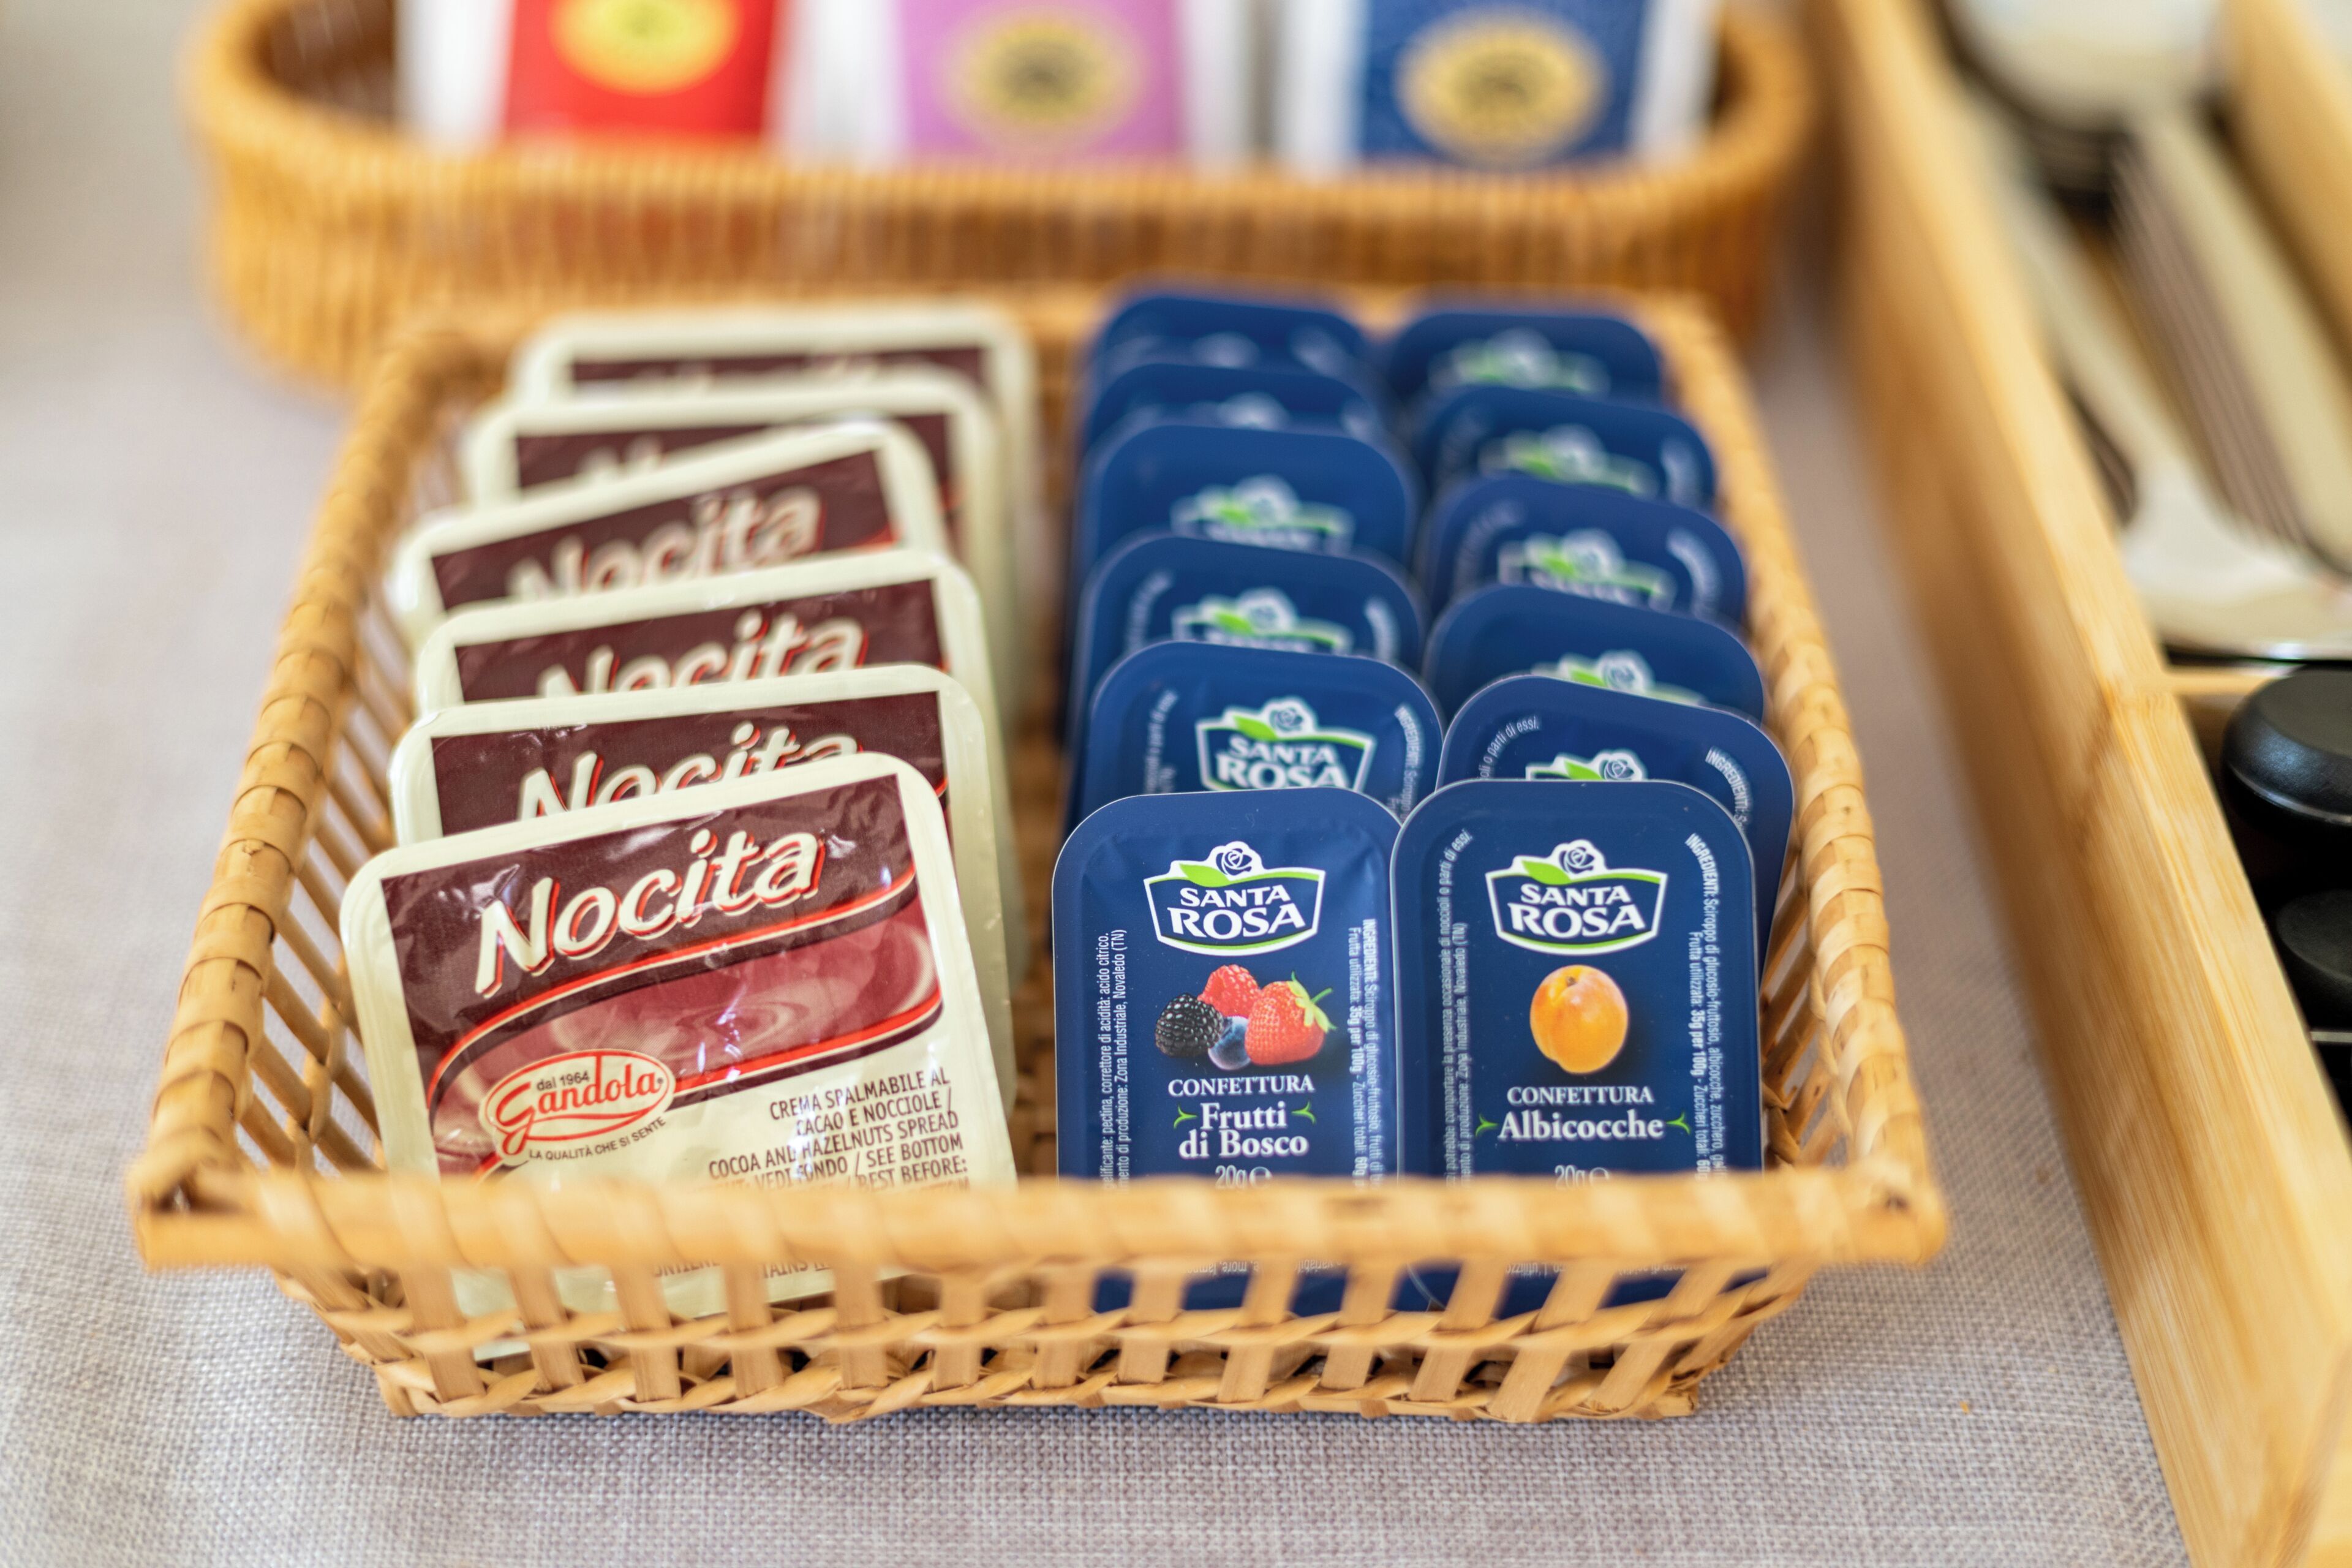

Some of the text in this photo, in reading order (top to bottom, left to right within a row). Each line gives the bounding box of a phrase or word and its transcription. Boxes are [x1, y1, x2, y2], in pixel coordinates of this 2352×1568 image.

[1227, 736, 1337, 766] SANTA
[1487, 731, 1507, 758] parti
[1505, 722, 1516, 738] di
[1516, 715, 1539, 733] essi.
[1216, 751, 1348, 790] ROSA
[1705, 747, 1749, 813] INGREDIENTI:
[1443, 847, 1457, 862] di
[1451, 828, 1474, 853] essi.
[1439, 859, 1453, 886] parti
[1684, 832, 1719, 897] INGREDIENTI:
[1179, 883, 1292, 908] SANTA
[1520, 883, 1632, 907] SANTA
[475, 829, 826, 1000] Nocita
[1167, 903, 1306, 941] ROSA
[1507, 904, 1646, 938] ROSA
[1702, 898, 1719, 942] Sciroppo
[1096, 933, 1109, 966] citrico.
[1111, 929, 1128, 951] (TN)
[1348, 927, 1361, 957] Frutta
[1438, 937, 1450, 947] di
[1452, 922, 1469, 946] (TN)
[1689, 932, 1704, 960] Frutta
[1705, 944, 1720, 954] di
[1362, 918, 1378, 982] INGREDIENTI:
[1096, 968, 1110, 995] acido
[1112, 954, 1126, 999] Novaledo
[1349, 958, 1362, 1003] utilizzata:
[1453, 948, 1467, 994] Novaledo
[1689, 963, 1704, 1007] utilizzata:
[1096, 997, 1111, 1031] acidità:
[1348, 1005, 1362, 1026] 35g
[1364, 984, 1378, 1028] Sciroppo
[1703, 956, 1722, 1045] glucosio-fruttosio,
[1113, 1001, 1129, 1055] Industriale,
[1689, 1009, 1705, 1029] 35g
[1098, 1034, 1110, 1043] di
[1347, 1027, 1361, 1045] per
[1366, 1031, 1379, 1041] di
[1689, 1031, 1705, 1049] per
[1098, 1046, 1112, 1094] correttore
[1114, 1057, 1128, 1082] Zona
[1349, 1047, 1365, 1074] 100g
[1690, 1050, 1707, 1076] 100g
[1708, 1047, 1724, 1102] albicocche,
[537, 1070, 590, 1091] dal 1964
[769, 1067, 951, 1120] CREMA SPALMABILE AL
[1168, 1074, 1315, 1097] CONFETTURA
[1506, 1085, 1655, 1106] CONFETTURA
[496, 1055, 660, 1156] Gandola
[796, 1110, 843, 1136] CACAO
[850, 1108, 859, 1126] E
[864, 1091, 943, 1121] NOCCIOLE
[1099, 1096, 1115, 1134] pectina,
[1115, 1084, 1131, 1142] produzione:
[1200, 1101, 1287, 1130] Frutti
[1352, 1082, 1366, 1124] Zuccheri
[1694, 1085, 1709, 1127] Zuccheri
[529, 1117, 666, 1161] LA QUALITÀ CHE SI SENTE
[1354, 1126, 1366, 1154] totali:
[1498, 1108, 1665, 1141] Albicocche
[1709, 1104, 1725, 1152] zucchero,
[709, 1153, 761, 1181] COCOA
[801, 1122, 893, 1159] HAZELNUTS
[899, 1110, 959, 1139] SPREAD
[866, 1145, 895, 1168] SEE
[901, 1132, 963, 1161] BOTTOM
[1115, 1144, 1128, 1153] di
[1178, 1129, 1310, 1159] di Bosco
[1368, 1134, 1383, 1159] frutti
[1695, 1129, 1709, 1157] totali:
[858, 1168, 895, 1193] BEST
[900, 1155, 968, 1185] BEFORE:
[1352, 1156, 1368, 1177] 60g
[1294, 1259, 1333, 1275] variabil
